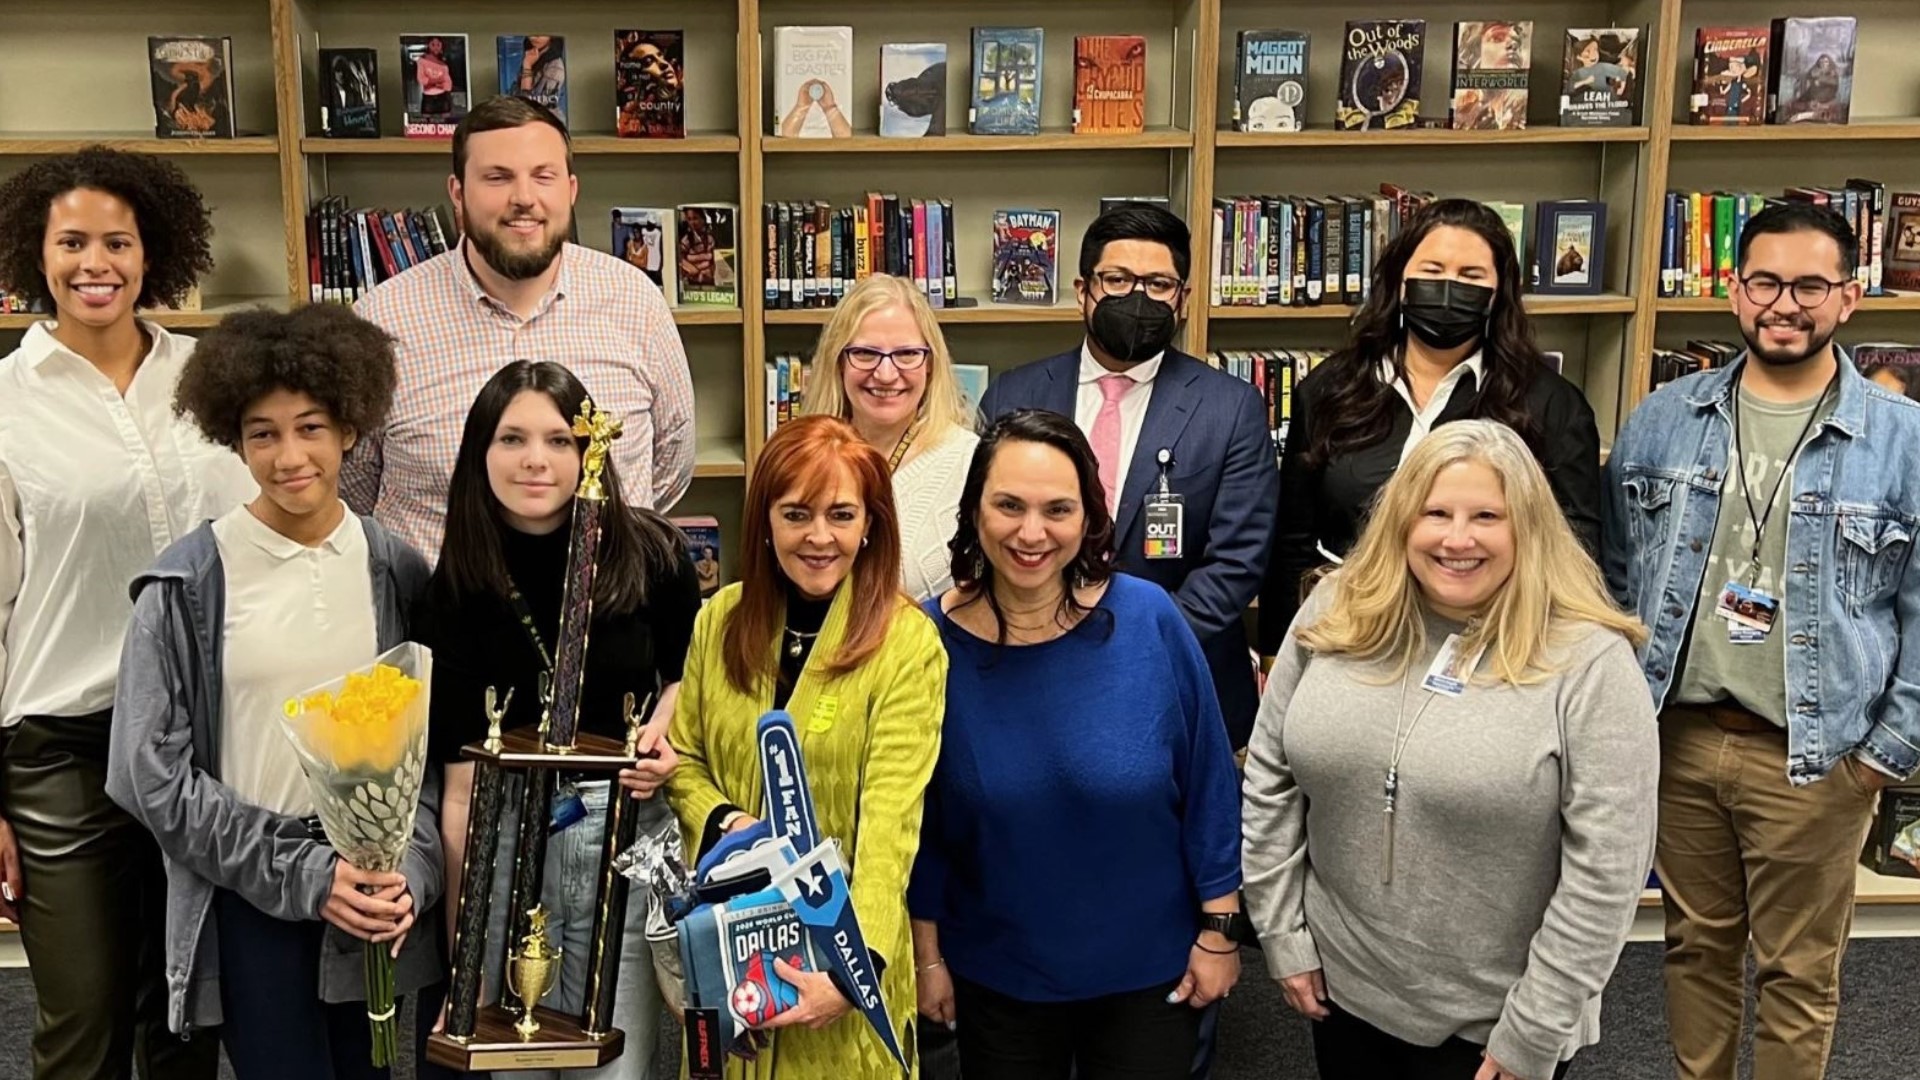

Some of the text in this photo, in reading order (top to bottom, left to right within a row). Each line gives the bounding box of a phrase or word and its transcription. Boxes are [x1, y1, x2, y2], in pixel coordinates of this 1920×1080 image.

[1349, 24, 1403, 47] Out of
[1247, 41, 1306, 55] MAGGOT
[1348, 33, 1419, 60] the Woods
[1704, 36, 1767, 53] CINDERELLA
[793, 50, 837, 61] BIG FAT
[785, 63, 847, 76] DISASTER
[1246, 55, 1303, 74] MOON
[1456, 78, 1528, 88] INTERWORLD
[1583, 91, 1611, 102] LEAH
[640, 101, 681, 112] country
[1009, 213, 1052, 229] BATMAN
[857, 238, 867, 271] buzz
[707, 291, 734, 303] LEGACY
[1147, 523, 1177, 535] OUT
[769, 743, 794, 788] #1
[781, 790, 801, 837] FAN
[735, 922, 800, 963] DALLAS
[833, 929, 879, 1010] DALLAS
